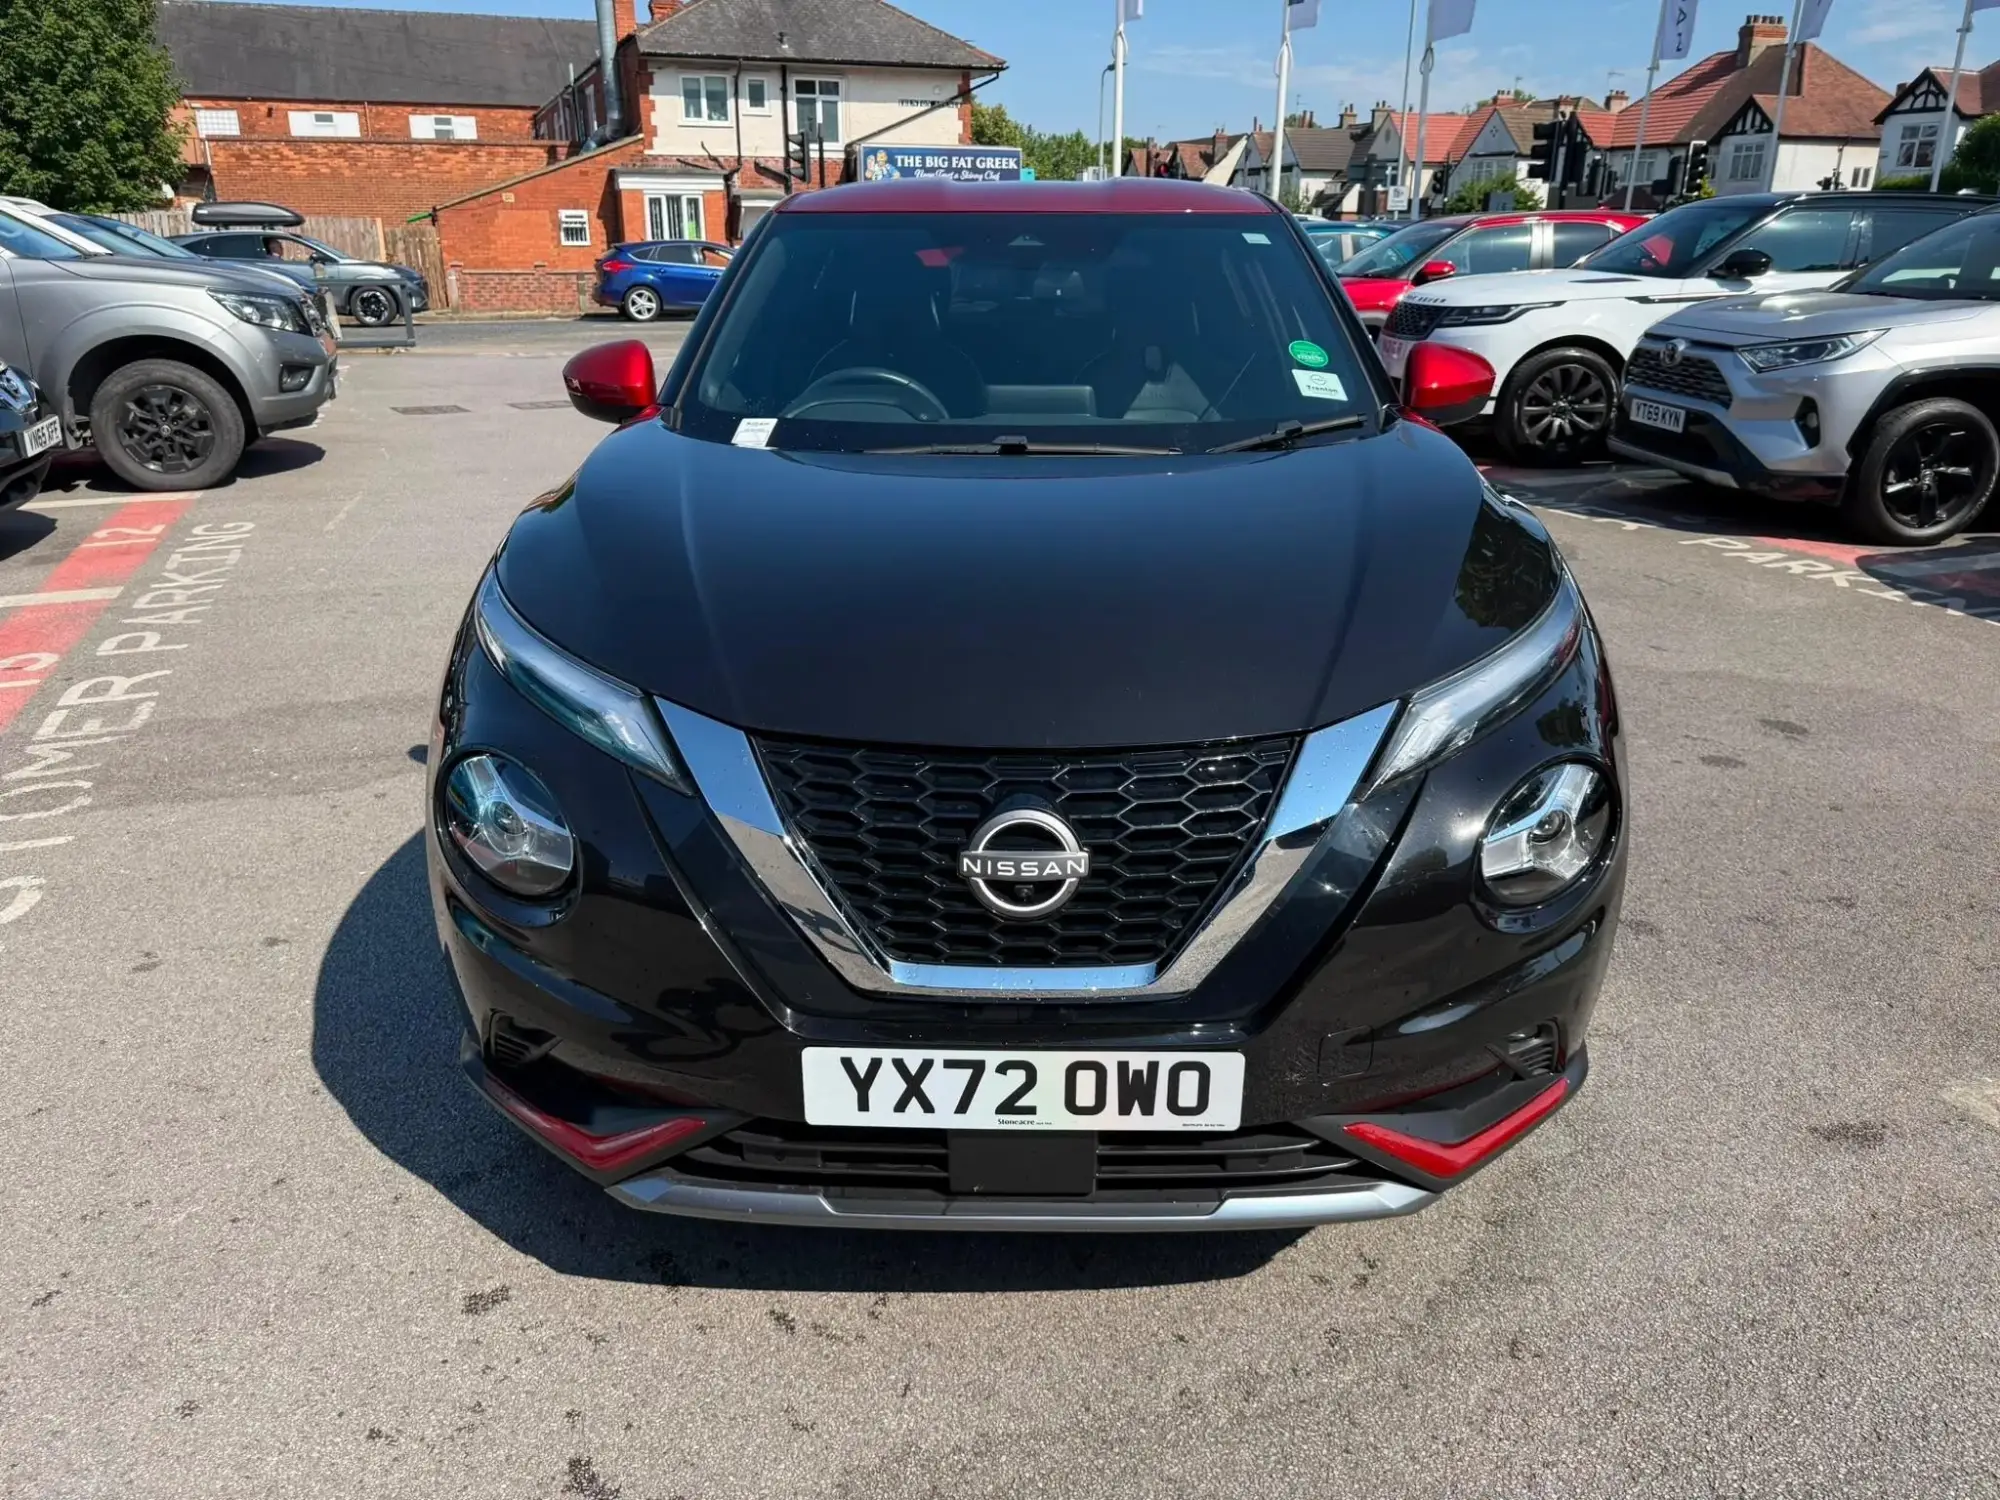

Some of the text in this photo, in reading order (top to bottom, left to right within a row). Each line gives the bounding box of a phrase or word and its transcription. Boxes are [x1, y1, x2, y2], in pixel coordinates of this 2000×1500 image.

[894, 155, 1019, 170] THE BIG FAT GREEK
[984, 170, 1001, 181] Chef
[1635, 401, 1681, 428] YT69 KYN
[80, 524, 166, 548] 12
[97, 521, 256, 656] PARKING
[962, 857, 1086, 876] NISSAN
[839, 1056, 1211, 1117] YX72 OWO
[997, 1117, 1036, 1126] Stoneacre
